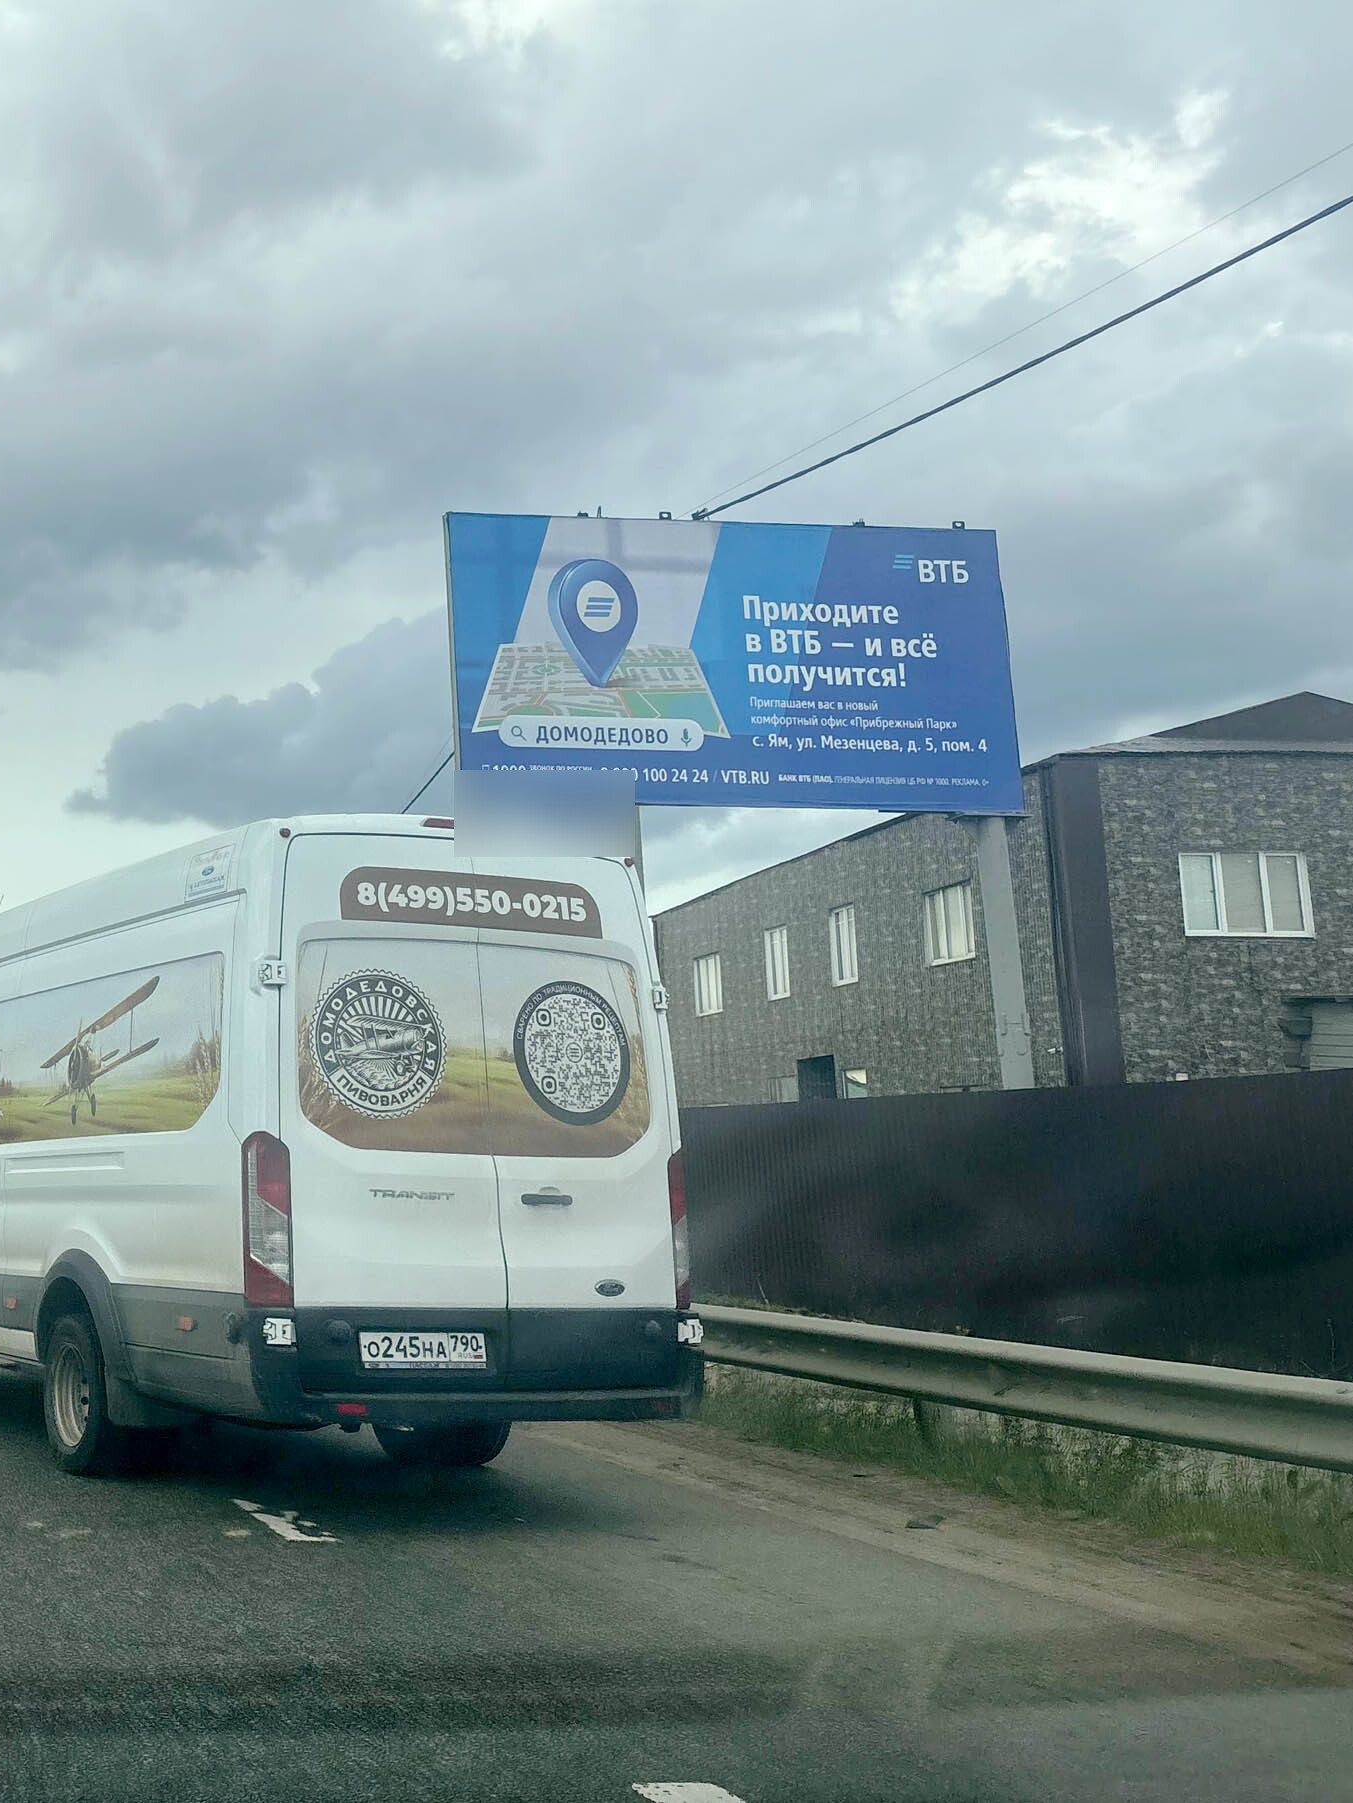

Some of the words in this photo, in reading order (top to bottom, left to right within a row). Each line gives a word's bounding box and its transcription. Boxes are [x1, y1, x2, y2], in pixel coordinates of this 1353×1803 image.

[917, 559, 969, 584] ВТБ
[742, 595, 899, 627] Приходите
[745, 633, 762, 652] в
[770, 629, 822, 655] ВТБ
[864, 637, 883, 657] и
[890, 633, 938, 658] всё
[747, 662, 907, 692] получится!
[750, 696, 816, 710] Приглашаем
[817, 701, 835, 710] вас
[837, 702, 843, 710] в
[845, 699, 879, 711] новый
[536, 725, 669, 747] ДОМОДЕДОВО
[751, 714, 819, 728] комфортный
[820, 715, 849, 729] офис
[849, 715, 924, 731] «Прибрежный
[925, 717, 958, 732] Парк»
[752, 736, 764, 748] с.
[768, 733, 793, 750] Ям,
[796, 737, 817, 752] ул.
[820, 735, 904, 753] Мезенцева,
[907, 739, 921, 753] д.
[925, 738, 938, 754] 5,
[941, 741, 975, 753] пом.
[978, 739, 988, 752] 4
[642, 768, 668, 782] 100
[671, 768, 688, 783] 24
[692, 769, 709, 783] 24
[720, 769, 770, 785] VTB.RU
[356, 881, 587, 922] 8(499)550-0215
[321, 980, 437, 1070] ДОМОДЕДОВСКАЯ
[516, 1002, 534, 1040] СВАРЕНО
[533, 993, 543, 1006] ПО
[336, 1073, 427, 1107] ПИВОВАРНЯ
